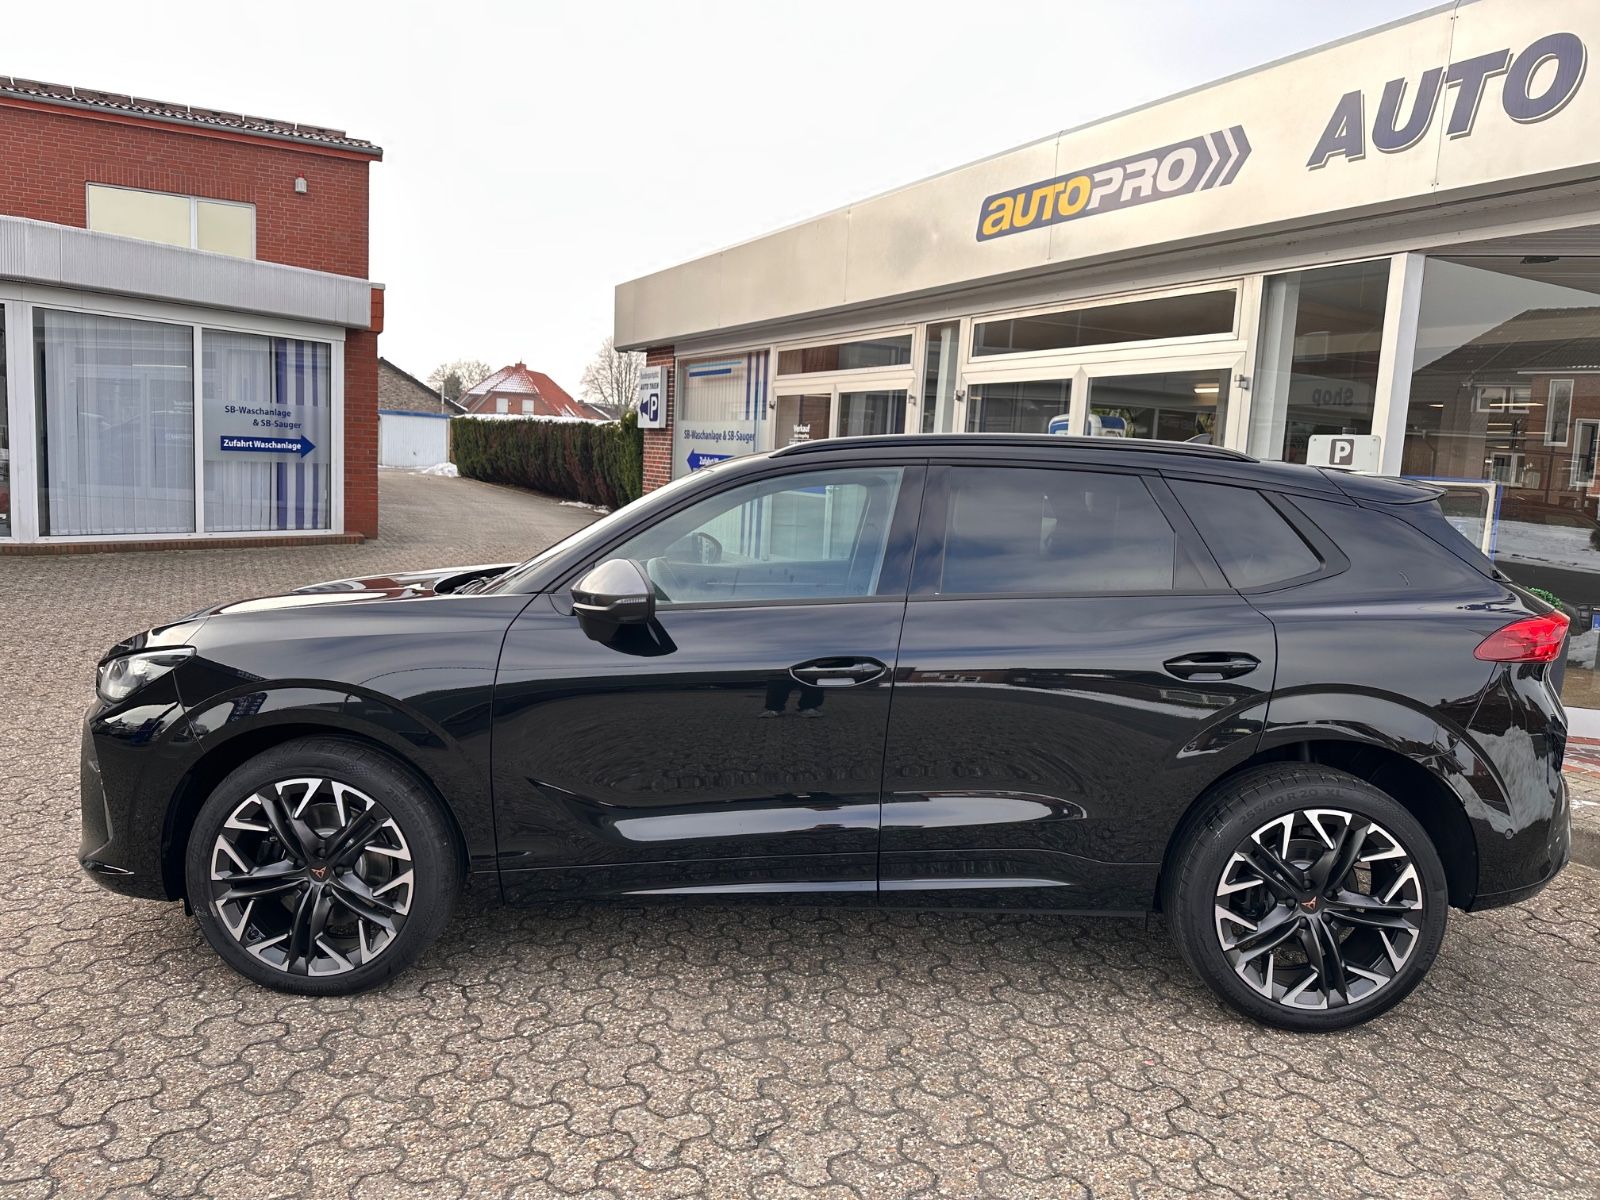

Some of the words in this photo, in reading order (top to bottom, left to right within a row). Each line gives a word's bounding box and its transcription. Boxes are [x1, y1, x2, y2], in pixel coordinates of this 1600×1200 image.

[1307, 32, 1587, 171] AUTO
[224, 405, 292, 418] SB-Waschanlage
[252, 419, 259, 427] &
[260, 419, 302, 430] SB-Sauger
[684, 429, 722, 443] SB-Waschanlage
[727, 430, 757, 444] SB-Sauger
[223, 439, 253, 448] Zufahrt
[253, 440, 302, 451] Waschanlage
